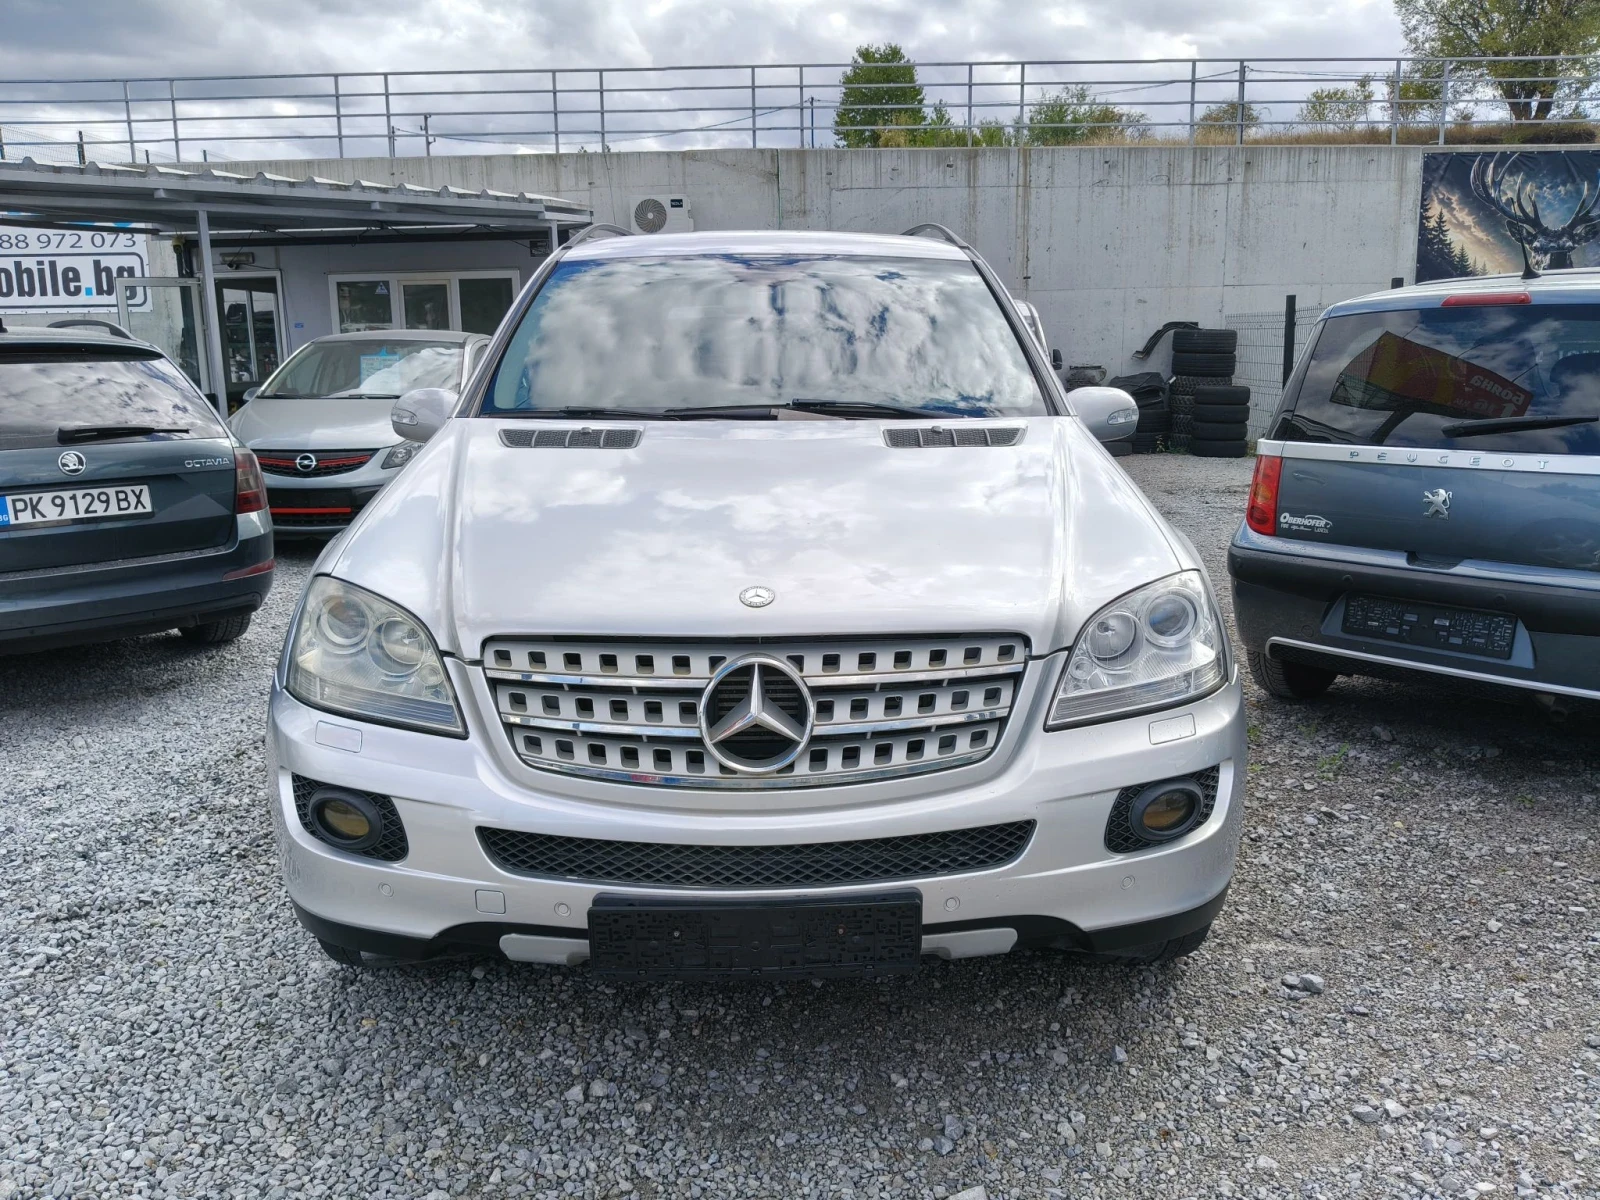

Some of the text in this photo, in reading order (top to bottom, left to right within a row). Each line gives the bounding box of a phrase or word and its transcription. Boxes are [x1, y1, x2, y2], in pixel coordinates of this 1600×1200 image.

[0, 232, 136, 249] 88 972 073
[184, 457, 230, 468] OCTAVIA
[1350, 450, 1549, 469] PEUGEOT
[11, 488, 147, 521] PK 9129 BX
